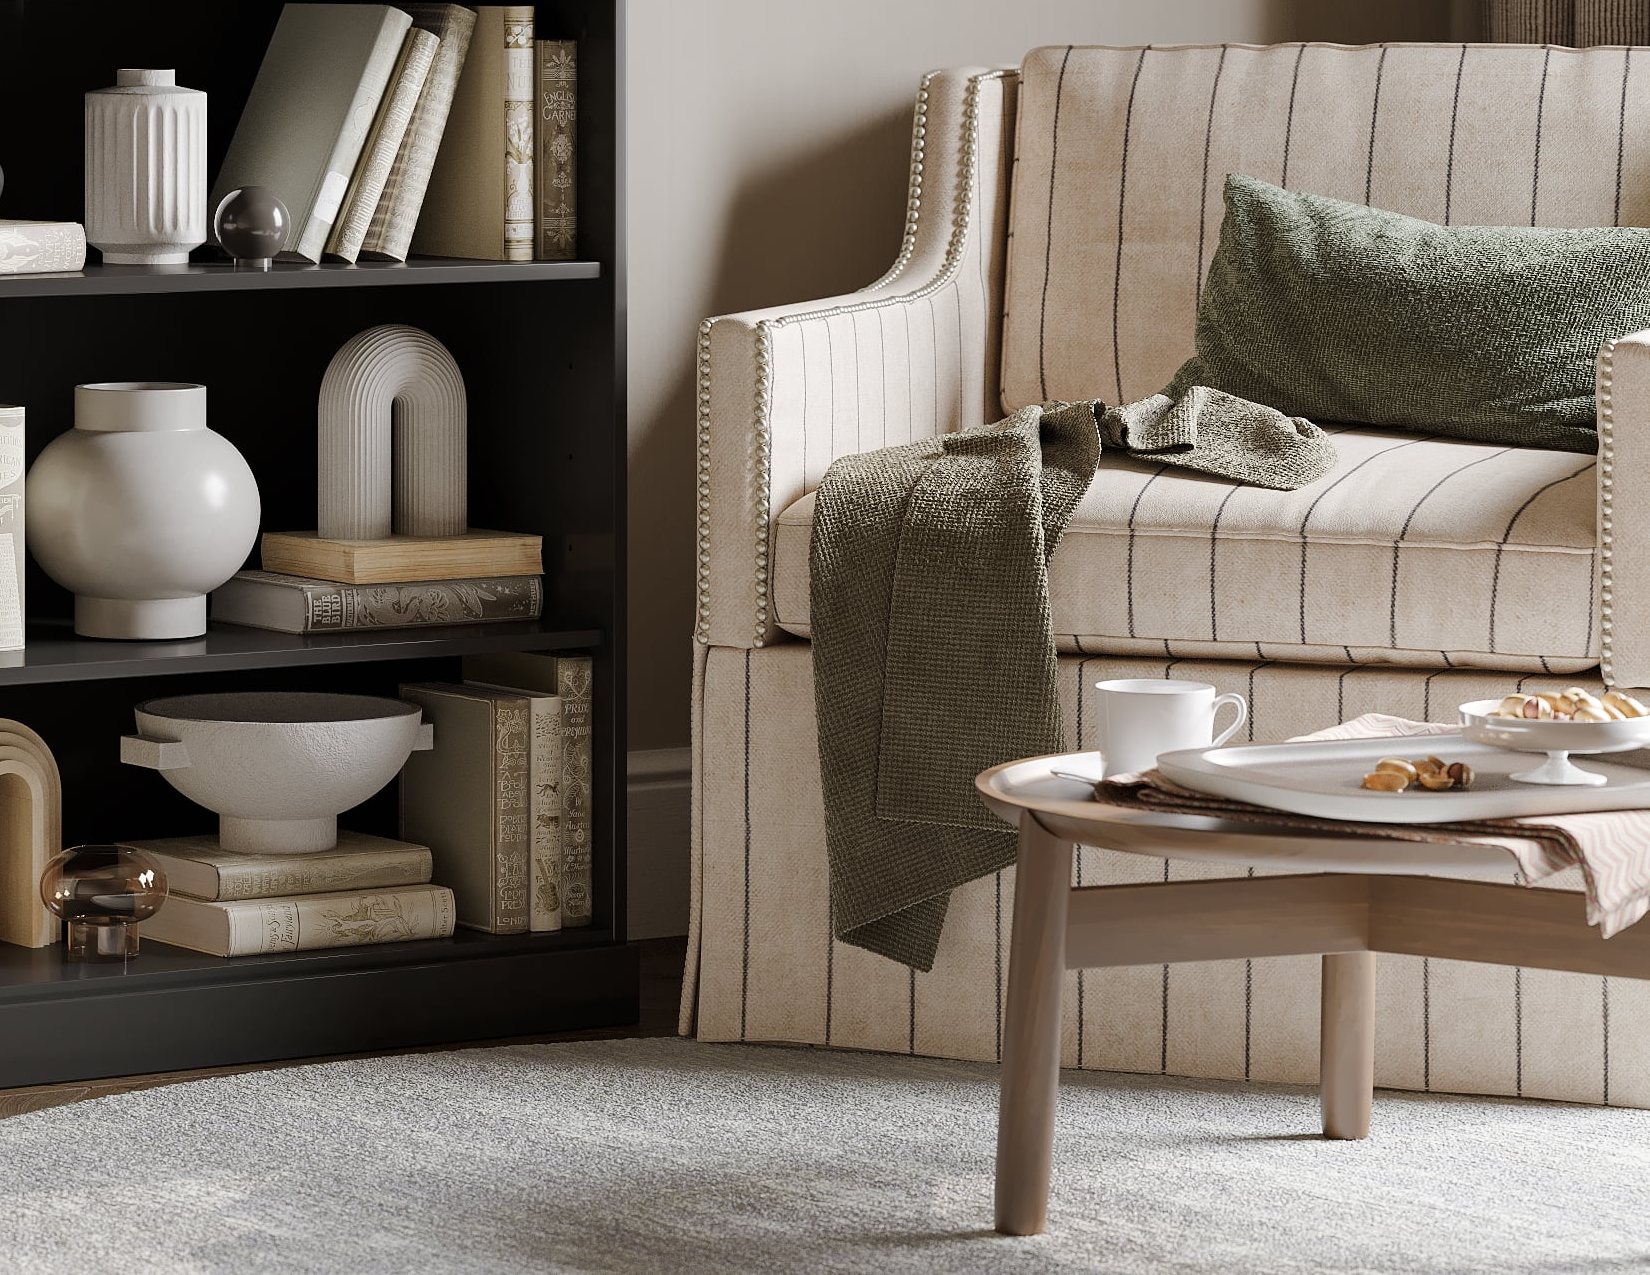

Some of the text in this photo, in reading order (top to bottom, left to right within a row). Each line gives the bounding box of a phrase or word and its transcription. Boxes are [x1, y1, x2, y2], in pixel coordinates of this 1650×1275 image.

[313, 600, 322, 623] THE
[322, 595, 331, 624] BLUE
[331, 594, 341, 623] BIRD
[570, 715, 585, 724] and
[281, 905, 295, 946] Fairyland
